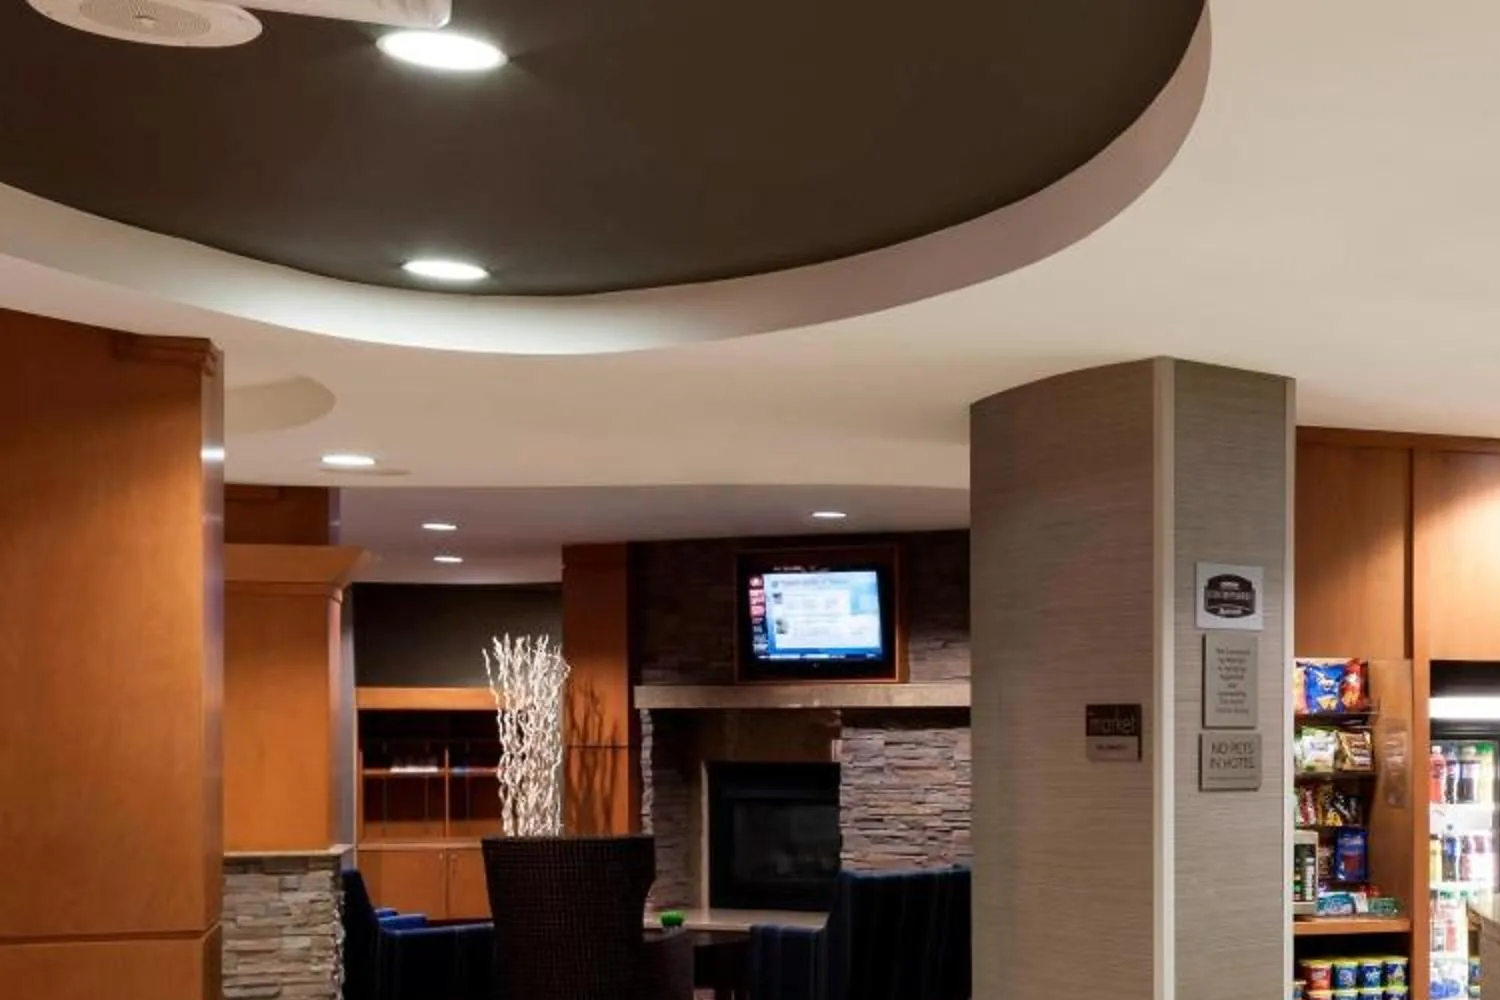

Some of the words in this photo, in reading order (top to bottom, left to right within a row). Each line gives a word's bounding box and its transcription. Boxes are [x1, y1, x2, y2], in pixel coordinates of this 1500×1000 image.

[1211, 741, 1229, 755] NO
[1231, 741, 1255, 755] PETS
[1223, 757, 1256, 769] HOTEL
